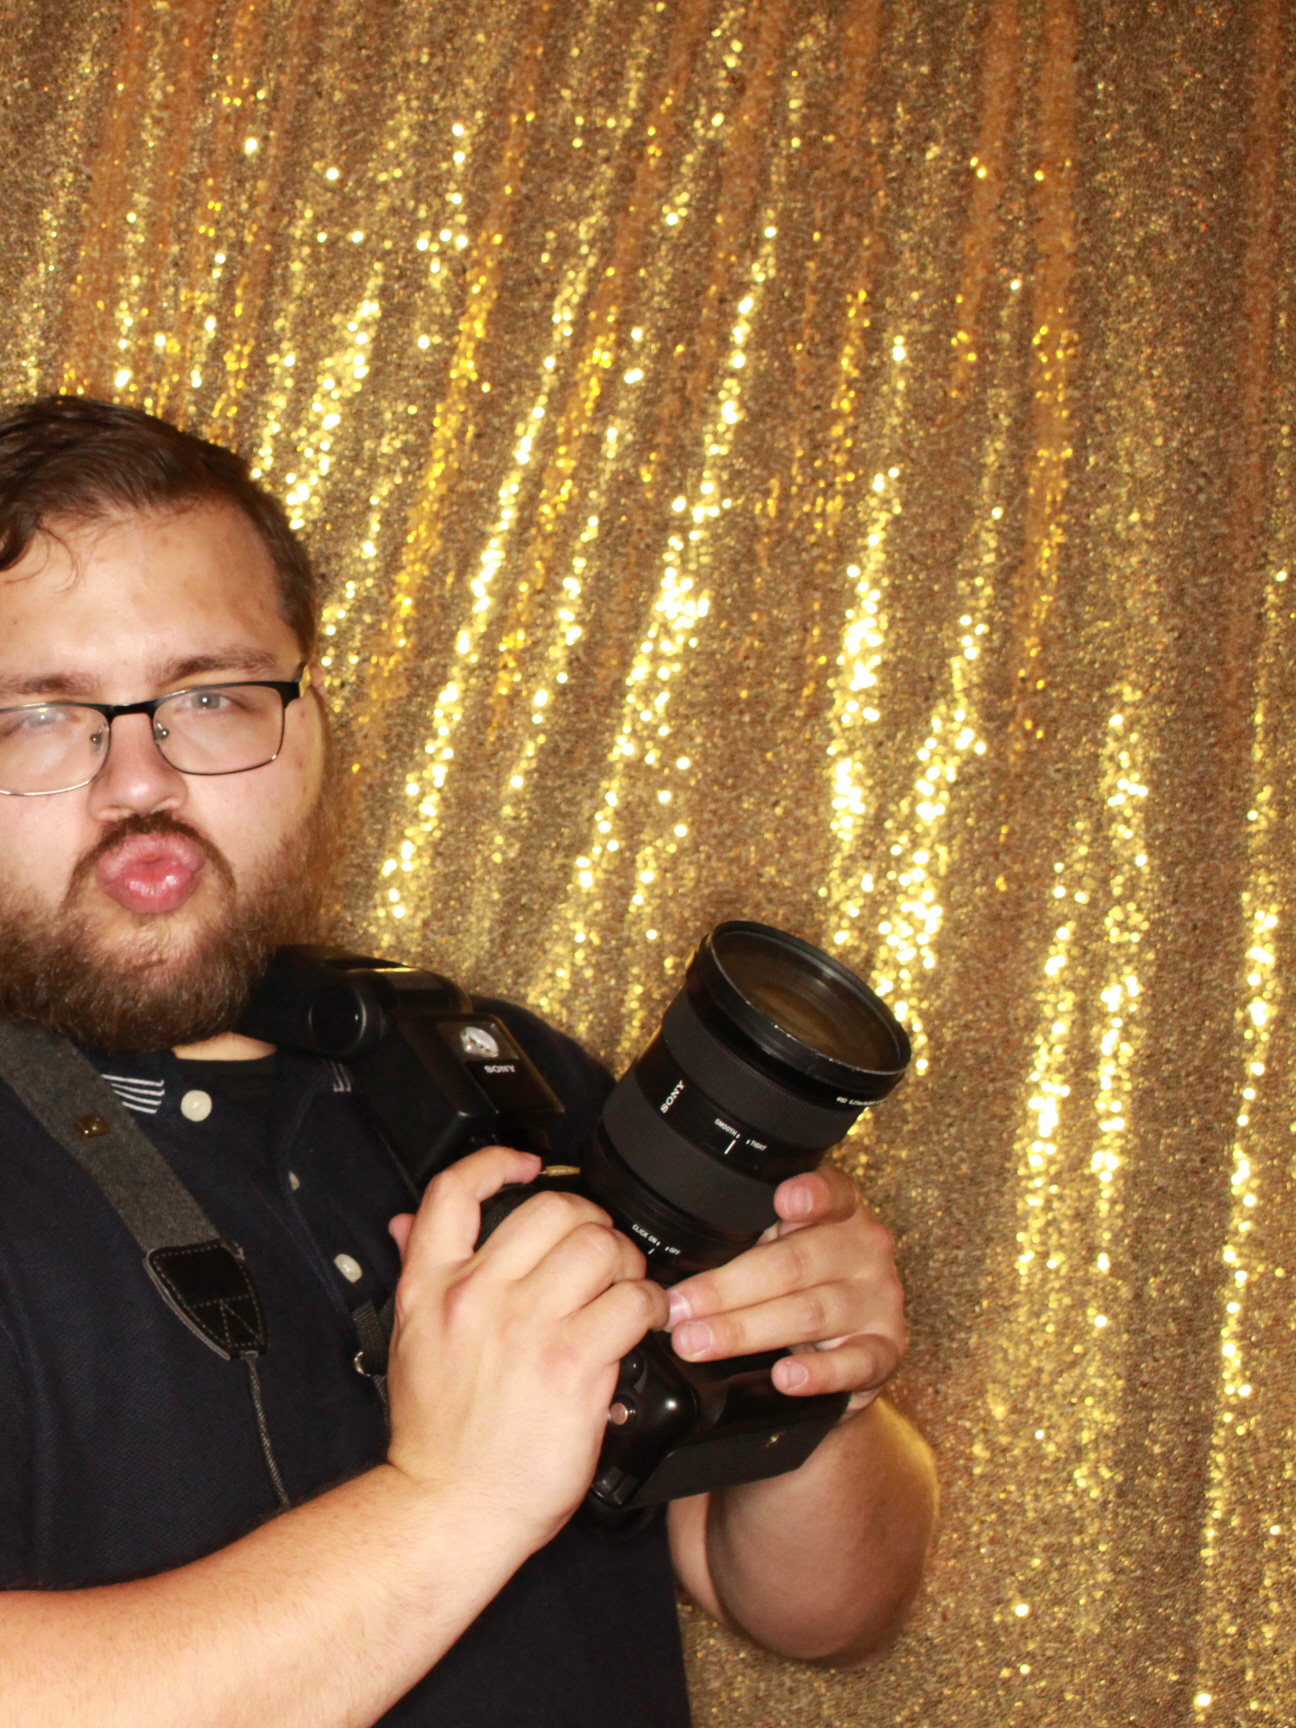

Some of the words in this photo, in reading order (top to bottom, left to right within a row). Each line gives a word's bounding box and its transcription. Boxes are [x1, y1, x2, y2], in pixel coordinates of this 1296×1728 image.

[484, 1065, 516, 1073] SONY
[660, 1079, 685, 1113] SONY
[714, 1118, 738, 1137] SMOOTH
[750, 1140, 767, 1151] TIGHT
[632, 1224, 649, 1239] CLICK
[648, 1235, 658, 1244] ON
